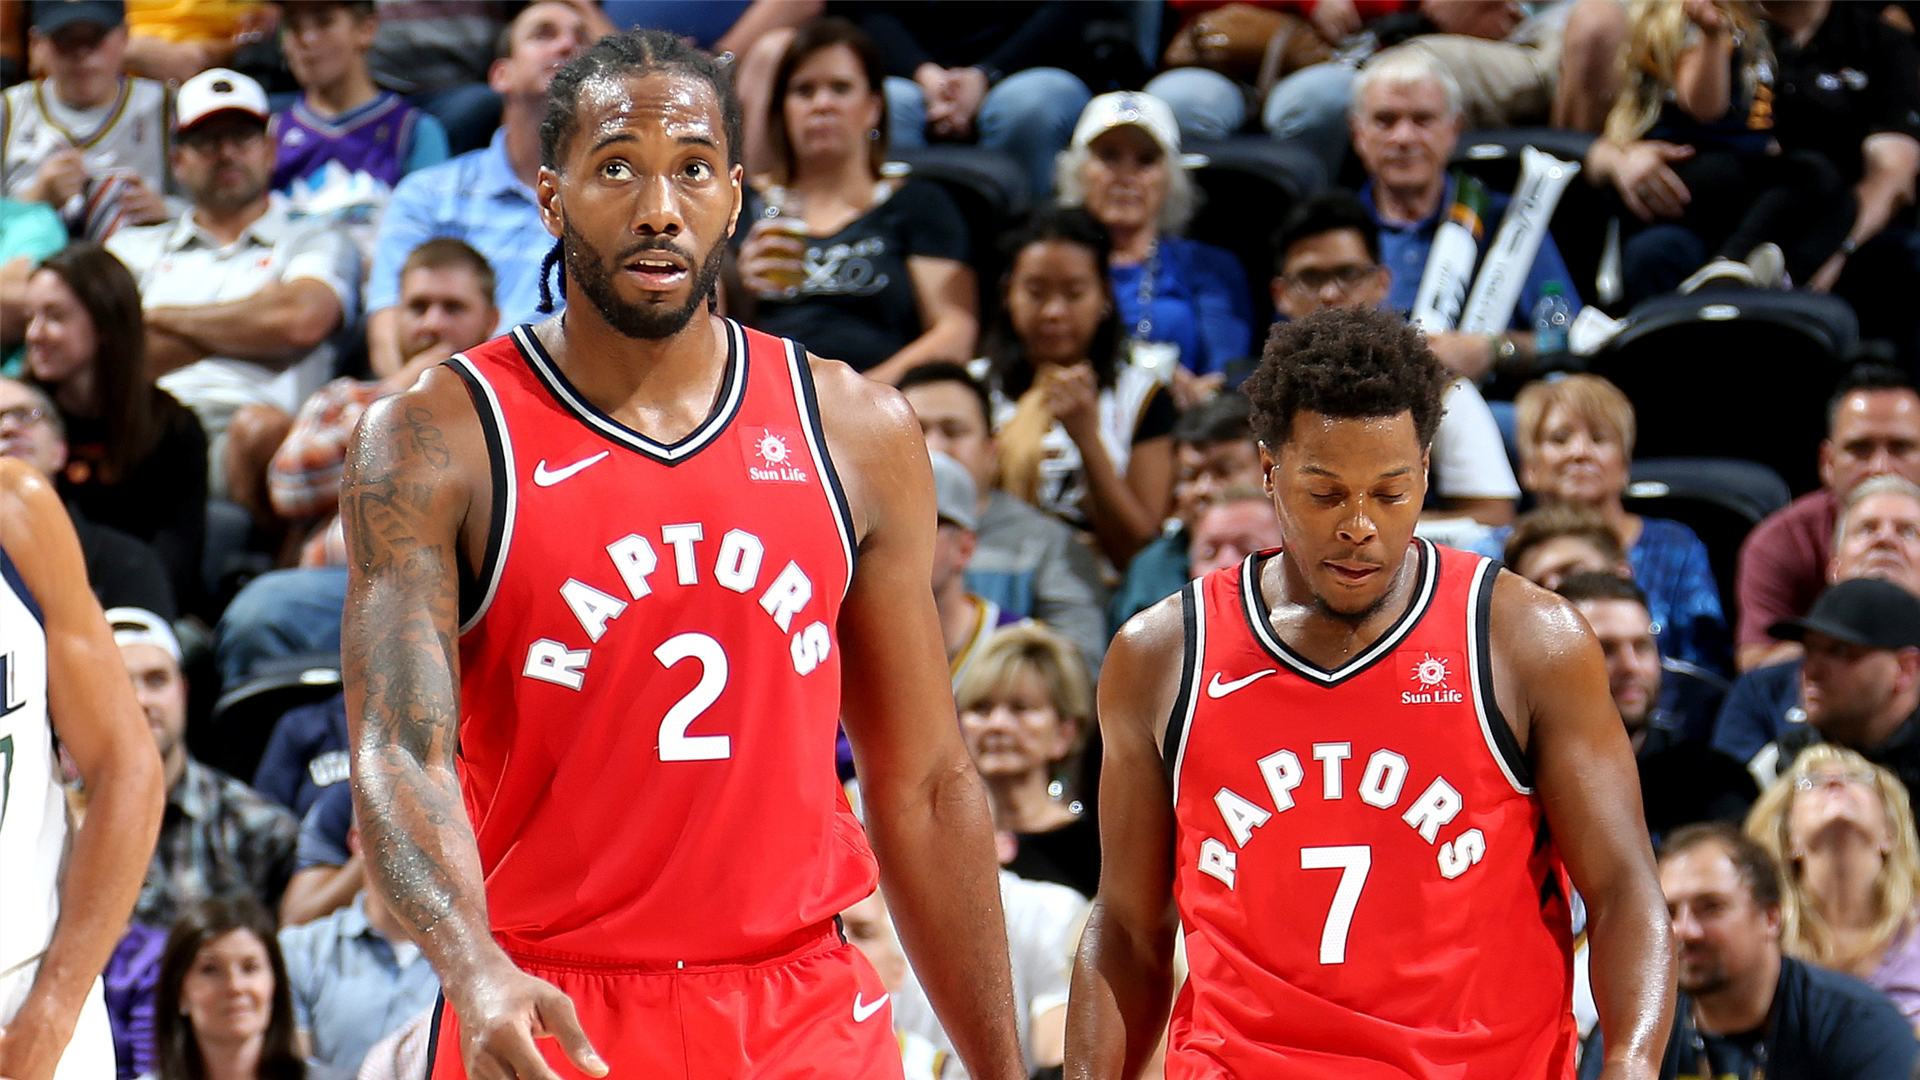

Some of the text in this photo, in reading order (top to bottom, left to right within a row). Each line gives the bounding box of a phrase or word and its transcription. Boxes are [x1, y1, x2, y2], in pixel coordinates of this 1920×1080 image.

[749, 467, 807, 482] Sun Life
[522, 522, 831, 691] RAPTORS
[652, 631, 731, 762] 2
[1401, 689, 1463, 704] Sun Life
[1197, 741, 1486, 891] RAPTORS
[1300, 844, 1372, 965] 7
